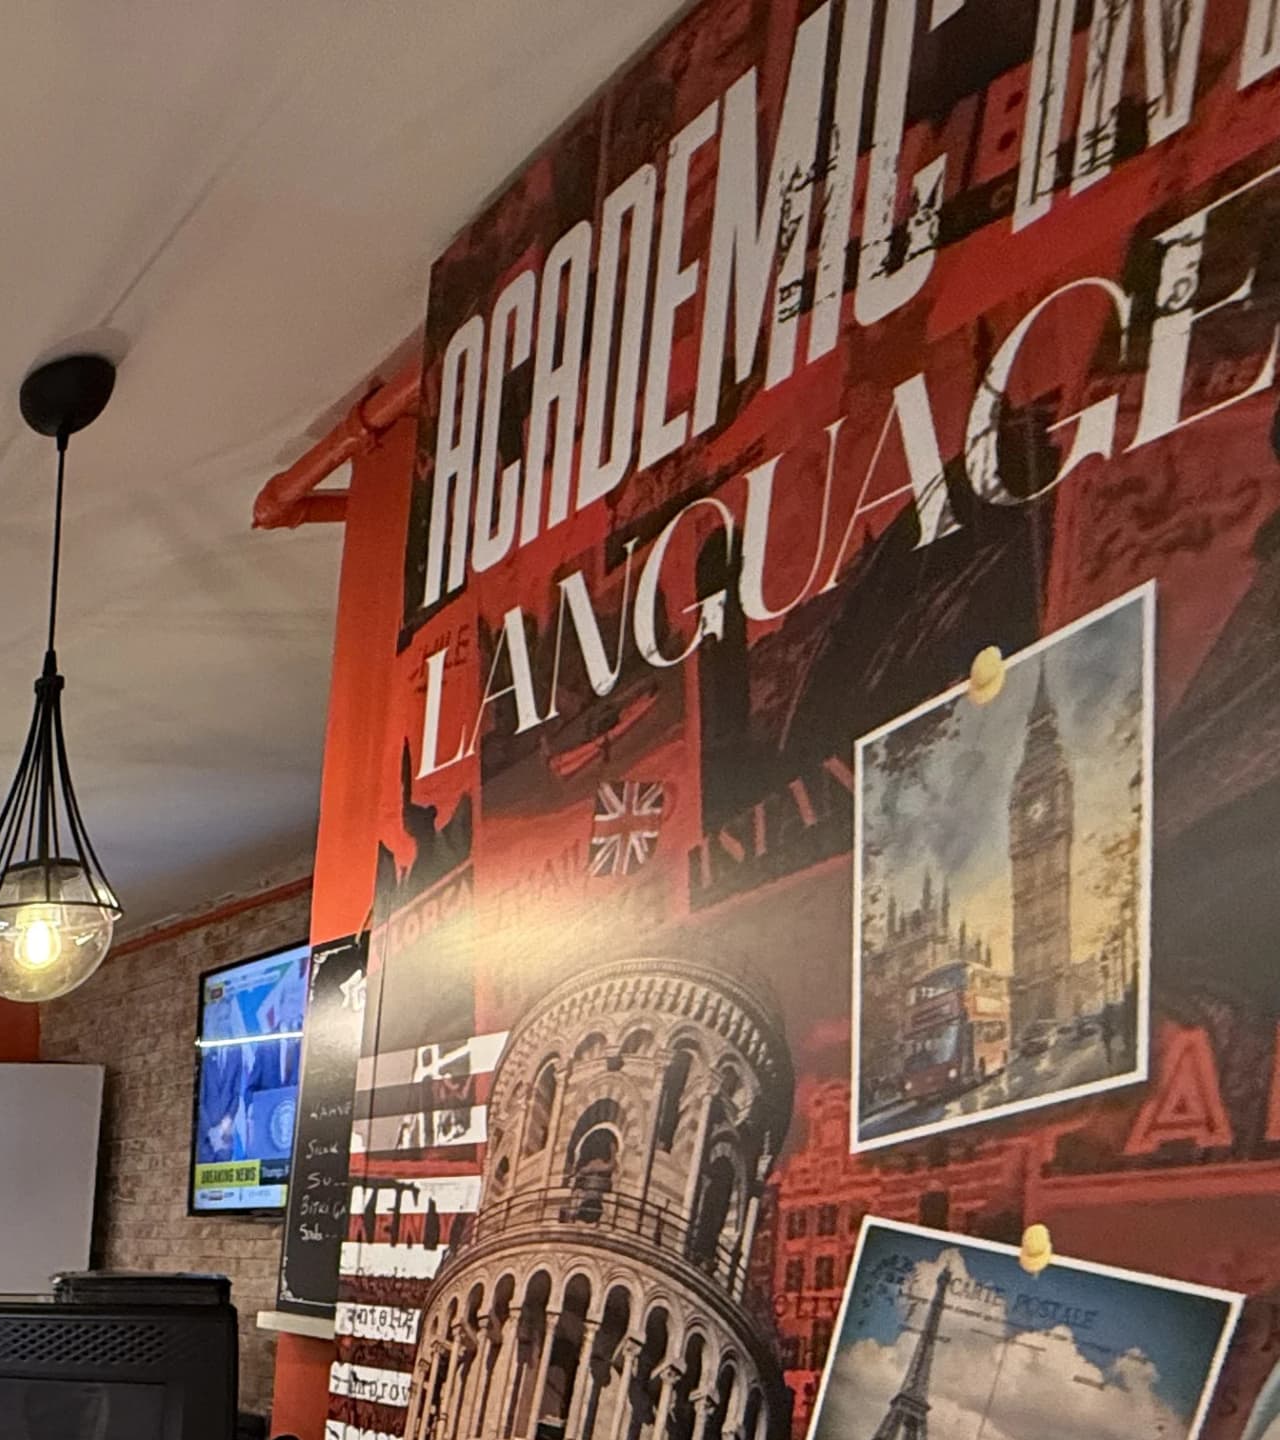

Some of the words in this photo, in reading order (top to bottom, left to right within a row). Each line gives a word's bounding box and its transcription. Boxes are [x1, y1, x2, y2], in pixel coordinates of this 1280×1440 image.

[415, 165, 1280, 780] LANGUAGE
[423, 0, 968, 608] ACADEMIC
[201, 1168, 234, 1184] BREAKING
[236, 1166, 257, 1182] NEWS
